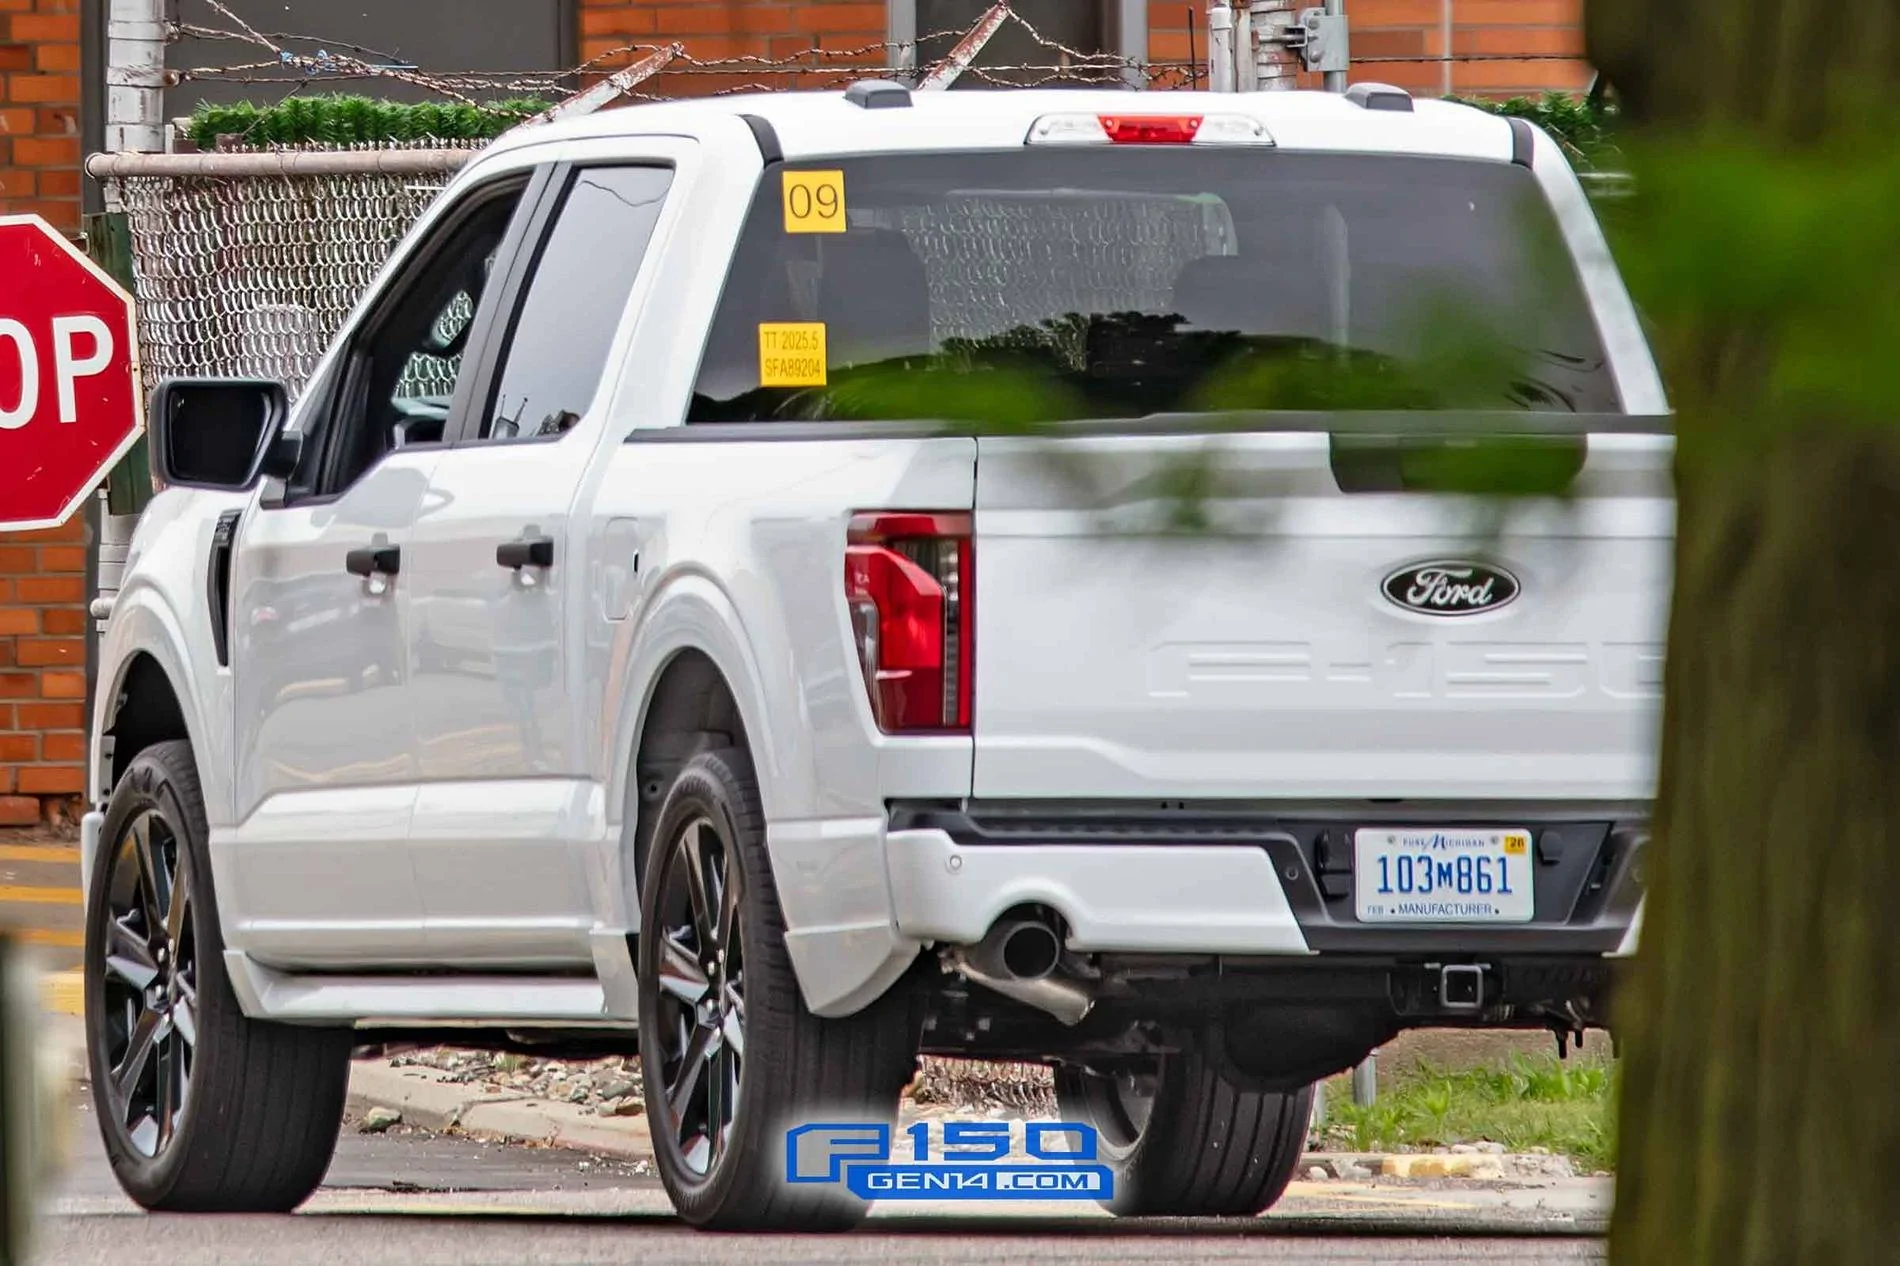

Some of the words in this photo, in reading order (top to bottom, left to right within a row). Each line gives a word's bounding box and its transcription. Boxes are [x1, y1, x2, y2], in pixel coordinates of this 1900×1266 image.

[789, 184, 839, 219] 09
[764, 331, 777, 349] TT
[782, 331, 819, 350] 2025.5
[765, 358, 821, 377] SFA89204
[1407, 568, 1494, 605] Ford
[1377, 855, 1512, 893] 103M861
[1398, 903, 1492, 915] MANUFACTURER
